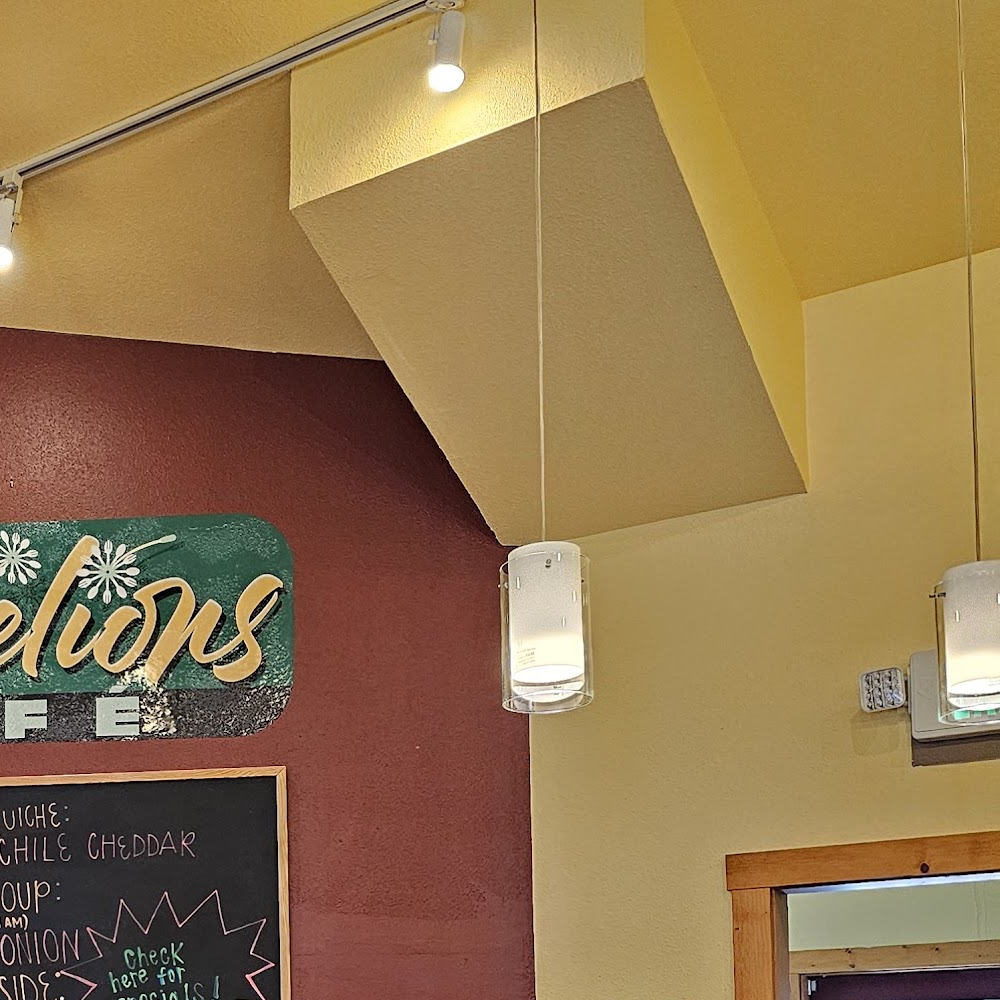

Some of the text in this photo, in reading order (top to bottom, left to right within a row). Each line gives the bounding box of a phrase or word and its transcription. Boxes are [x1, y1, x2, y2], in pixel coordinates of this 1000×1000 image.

[87, 830, 197, 860] CHEDDAR
[1, 928, 81, 966] ONION
[108, 965, 187, 994] here for
